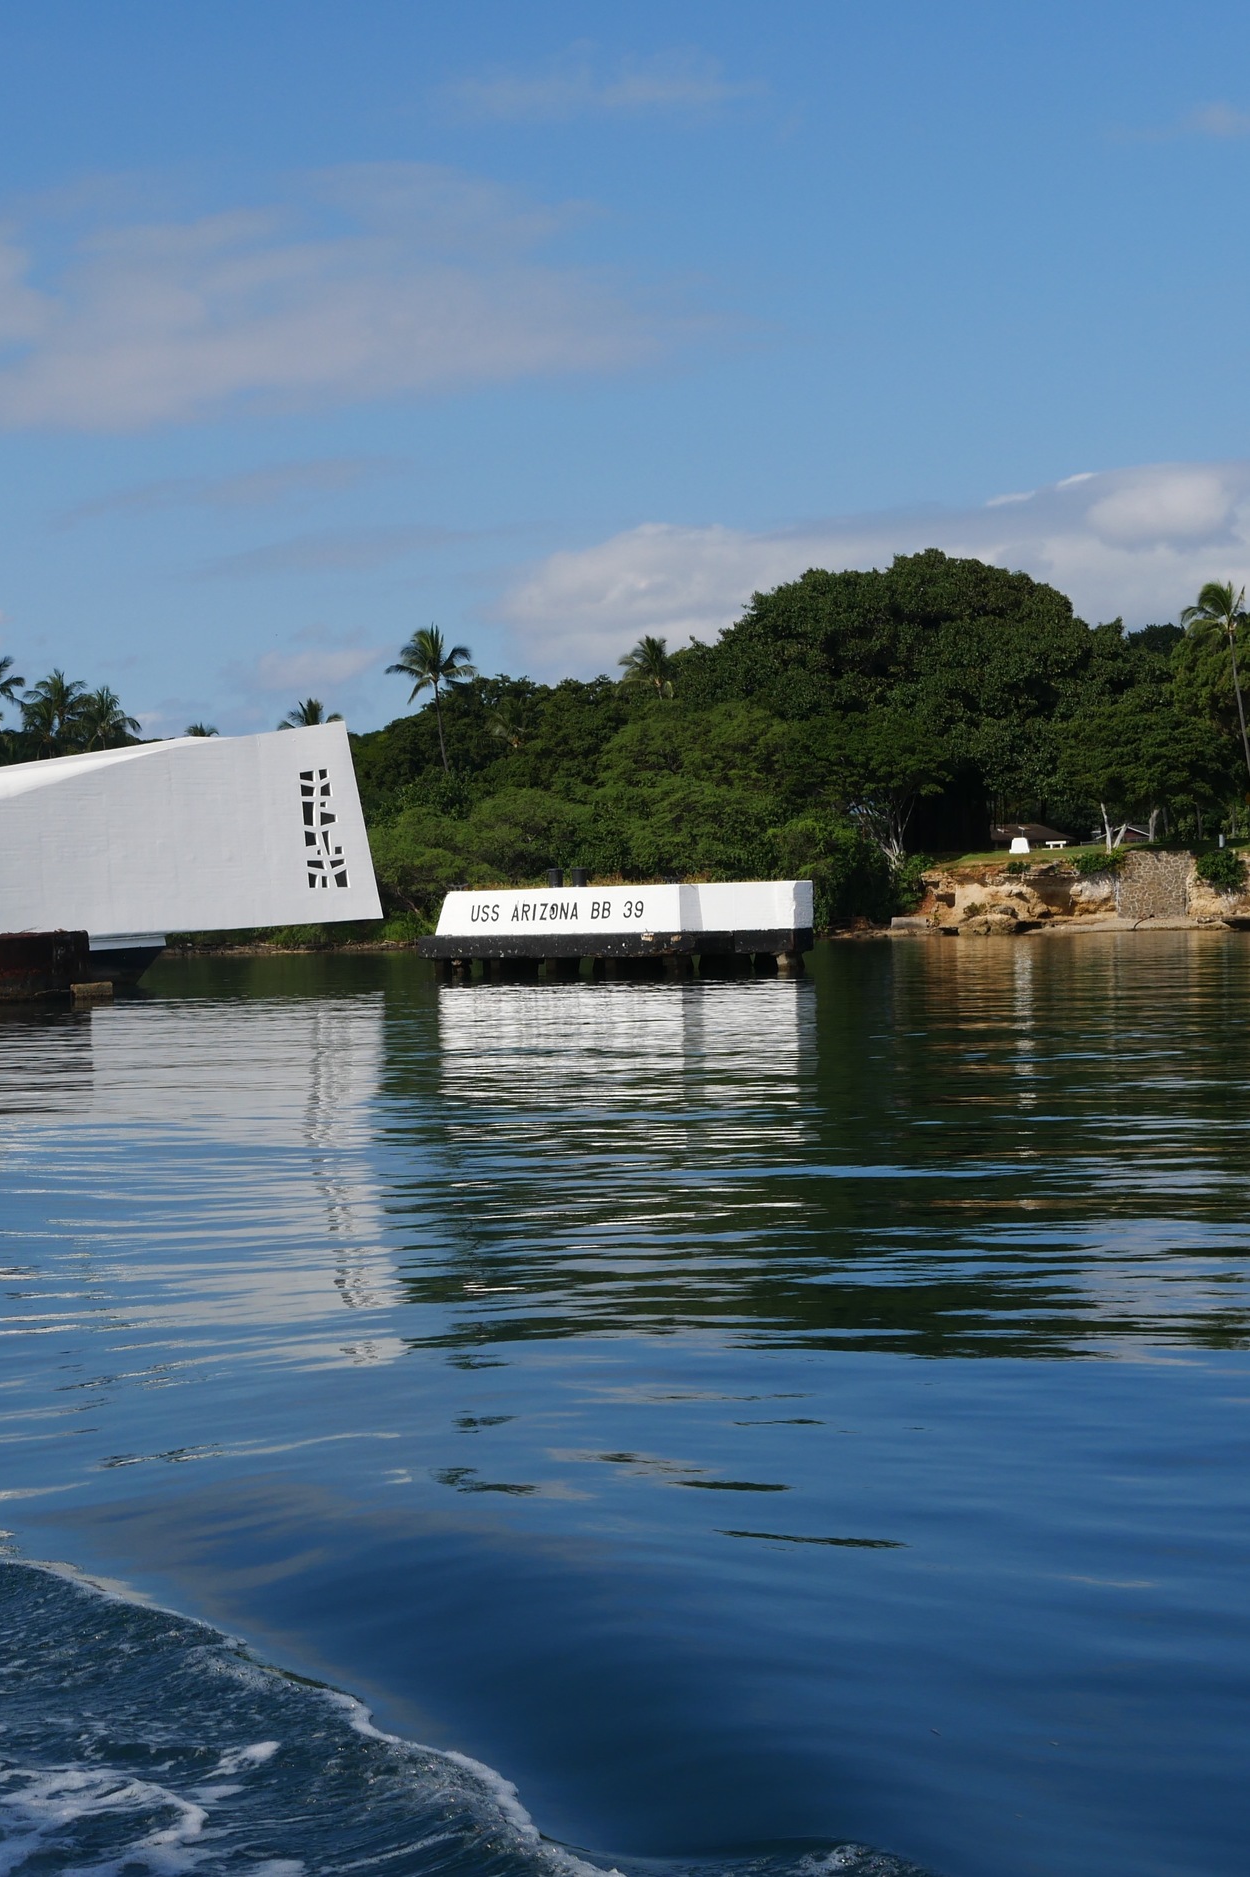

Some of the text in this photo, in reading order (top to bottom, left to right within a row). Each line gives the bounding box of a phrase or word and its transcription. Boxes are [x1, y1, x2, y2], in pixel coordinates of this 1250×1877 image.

[471, 900, 644, 922] USS ARIZONA BB 39
